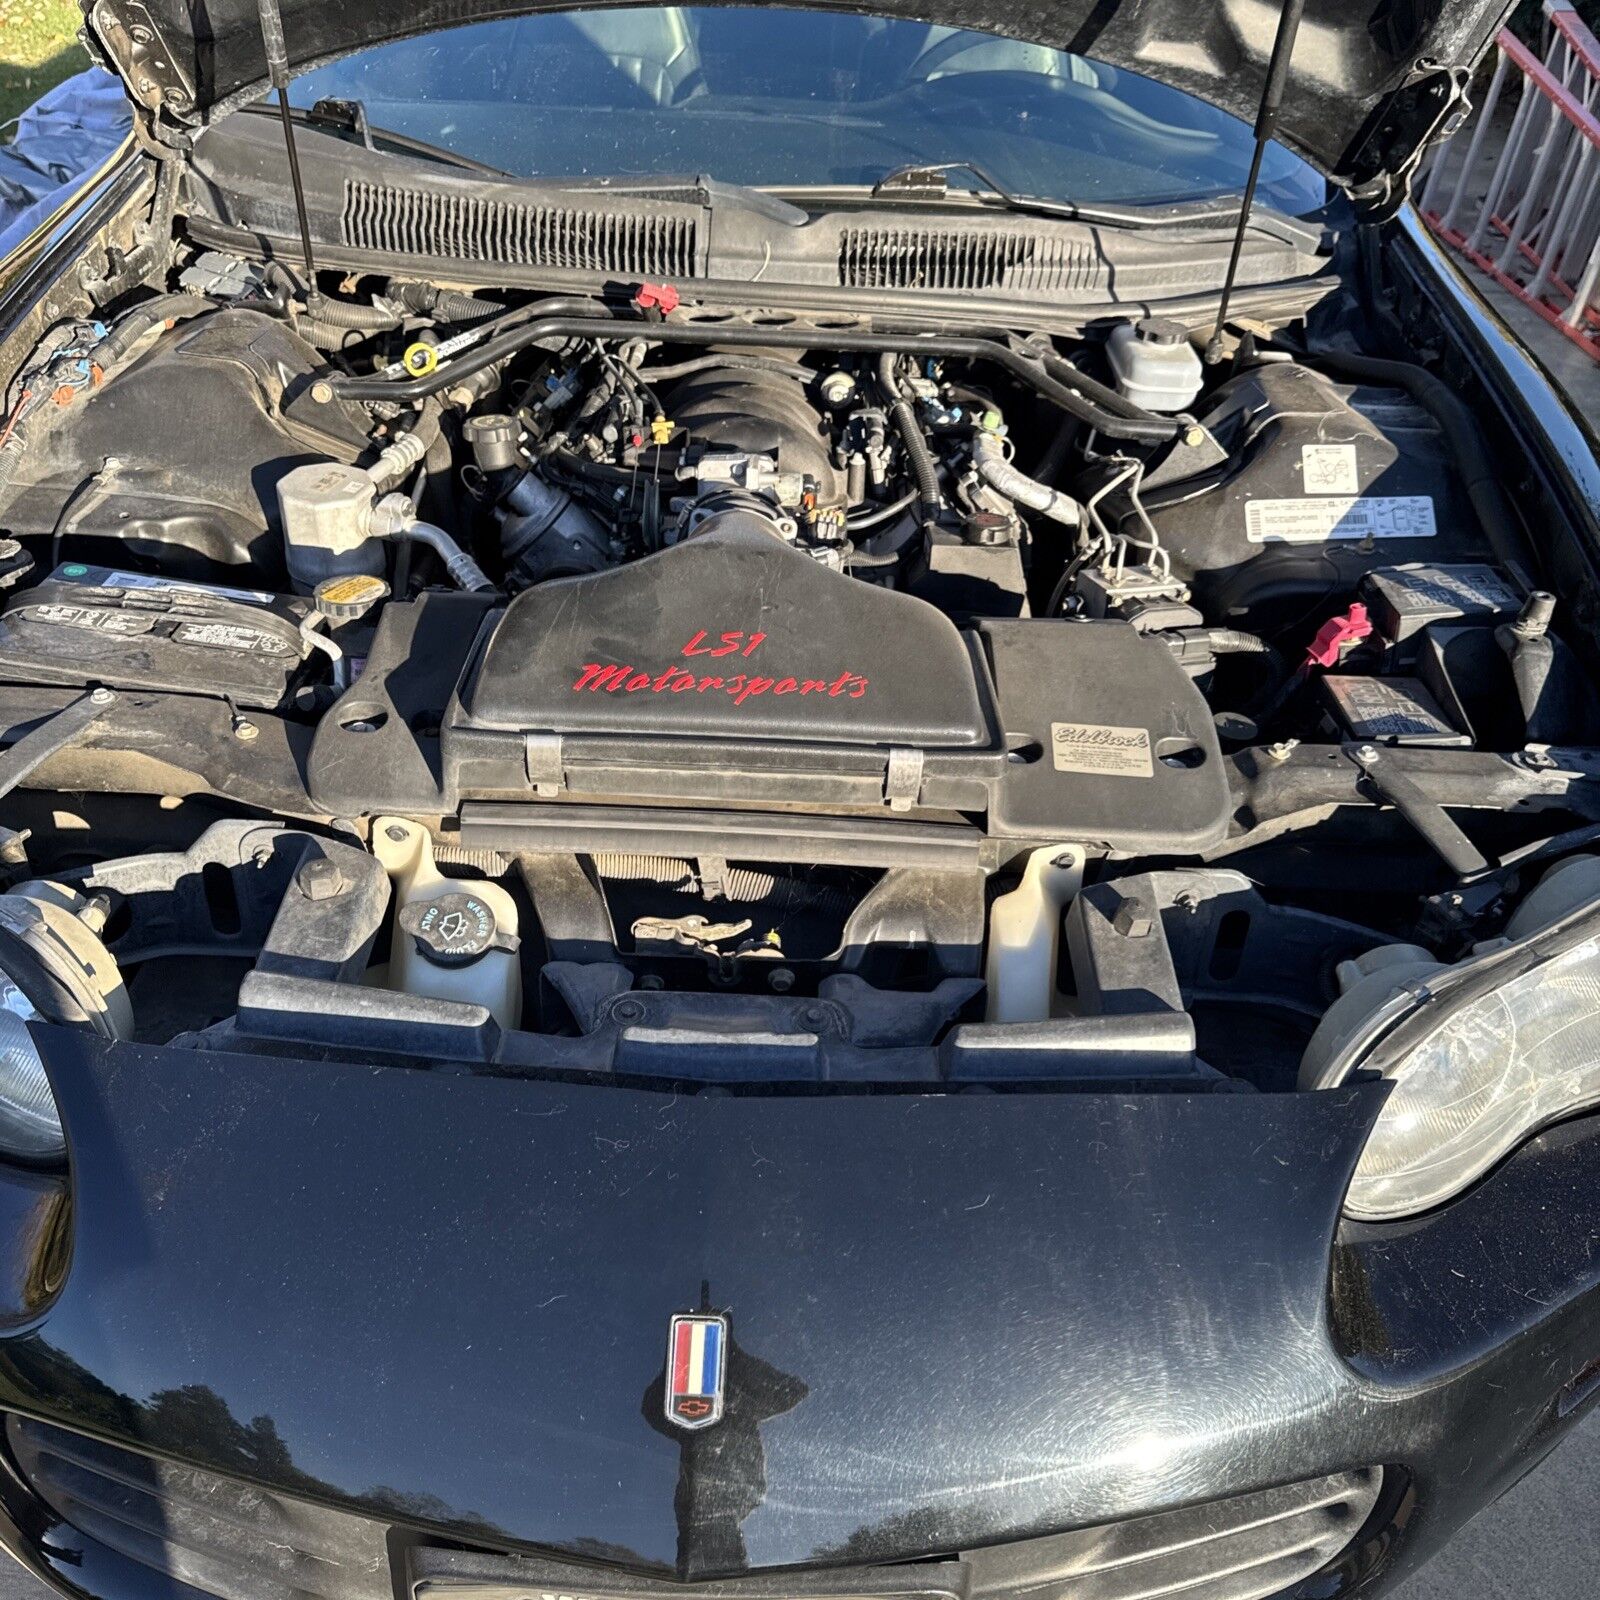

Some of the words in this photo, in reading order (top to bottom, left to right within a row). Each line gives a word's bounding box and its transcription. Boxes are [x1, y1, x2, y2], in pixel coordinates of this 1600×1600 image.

[682, 630, 767, 657] LS1
[573, 663, 870, 705] Motorsports
[1056, 728, 1148, 748] Edelbrock
[421, 908, 438, 931] ONLY
[467, 901, 488, 937] WASHER
